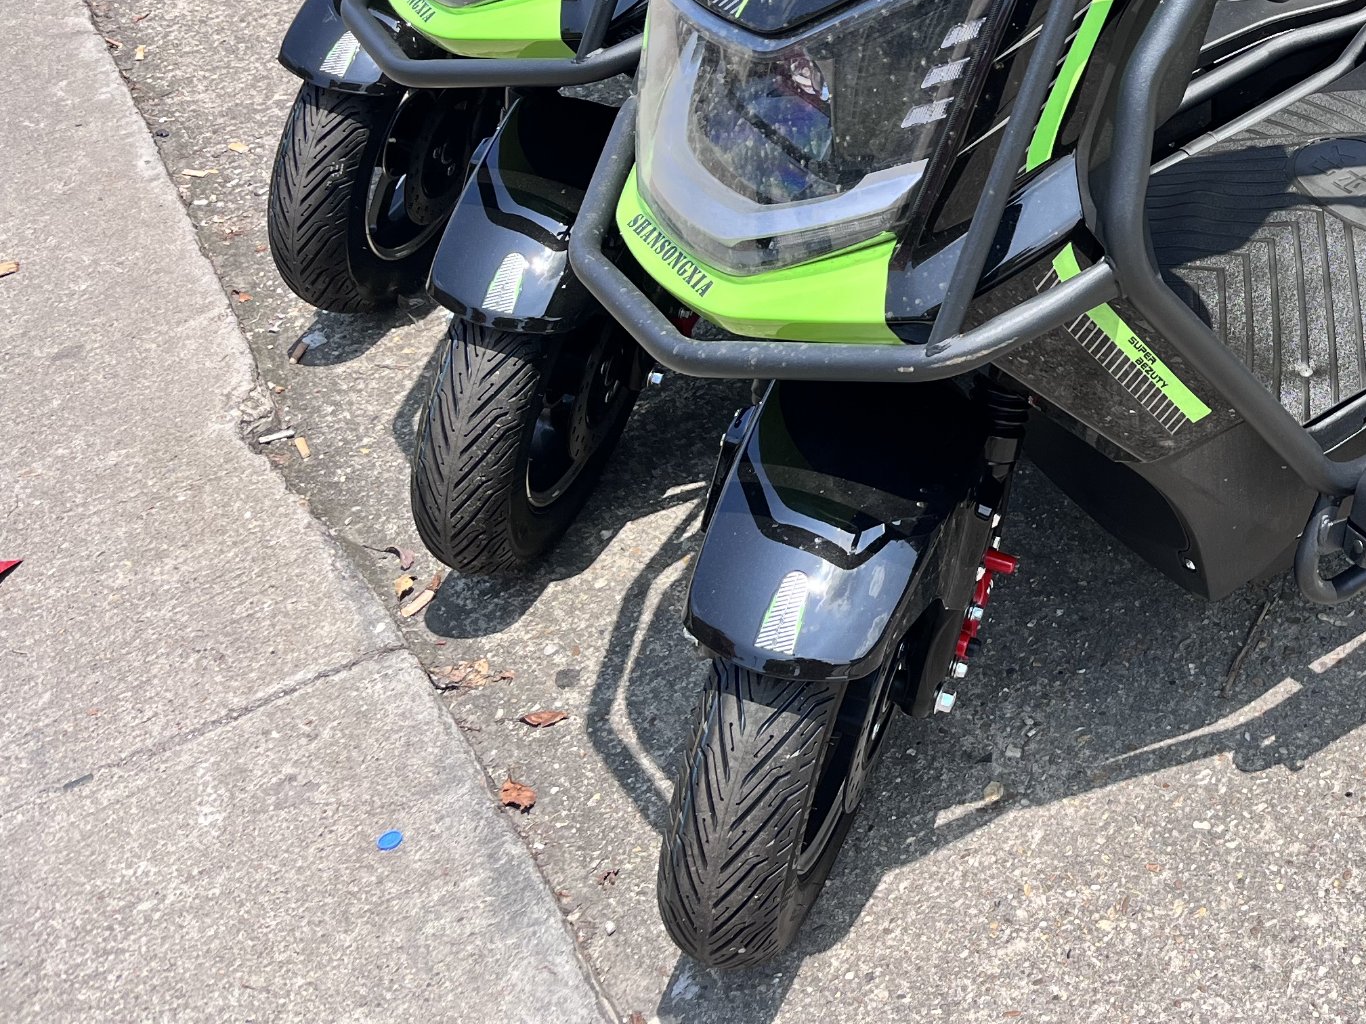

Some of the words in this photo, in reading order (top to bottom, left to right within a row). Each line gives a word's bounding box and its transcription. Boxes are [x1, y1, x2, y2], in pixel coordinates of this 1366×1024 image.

[626, 212, 715, 298] SHANSONGXIA
[1127, 335, 1157, 366] SUPER
[1134, 356, 1170, 389] BEZUTY
